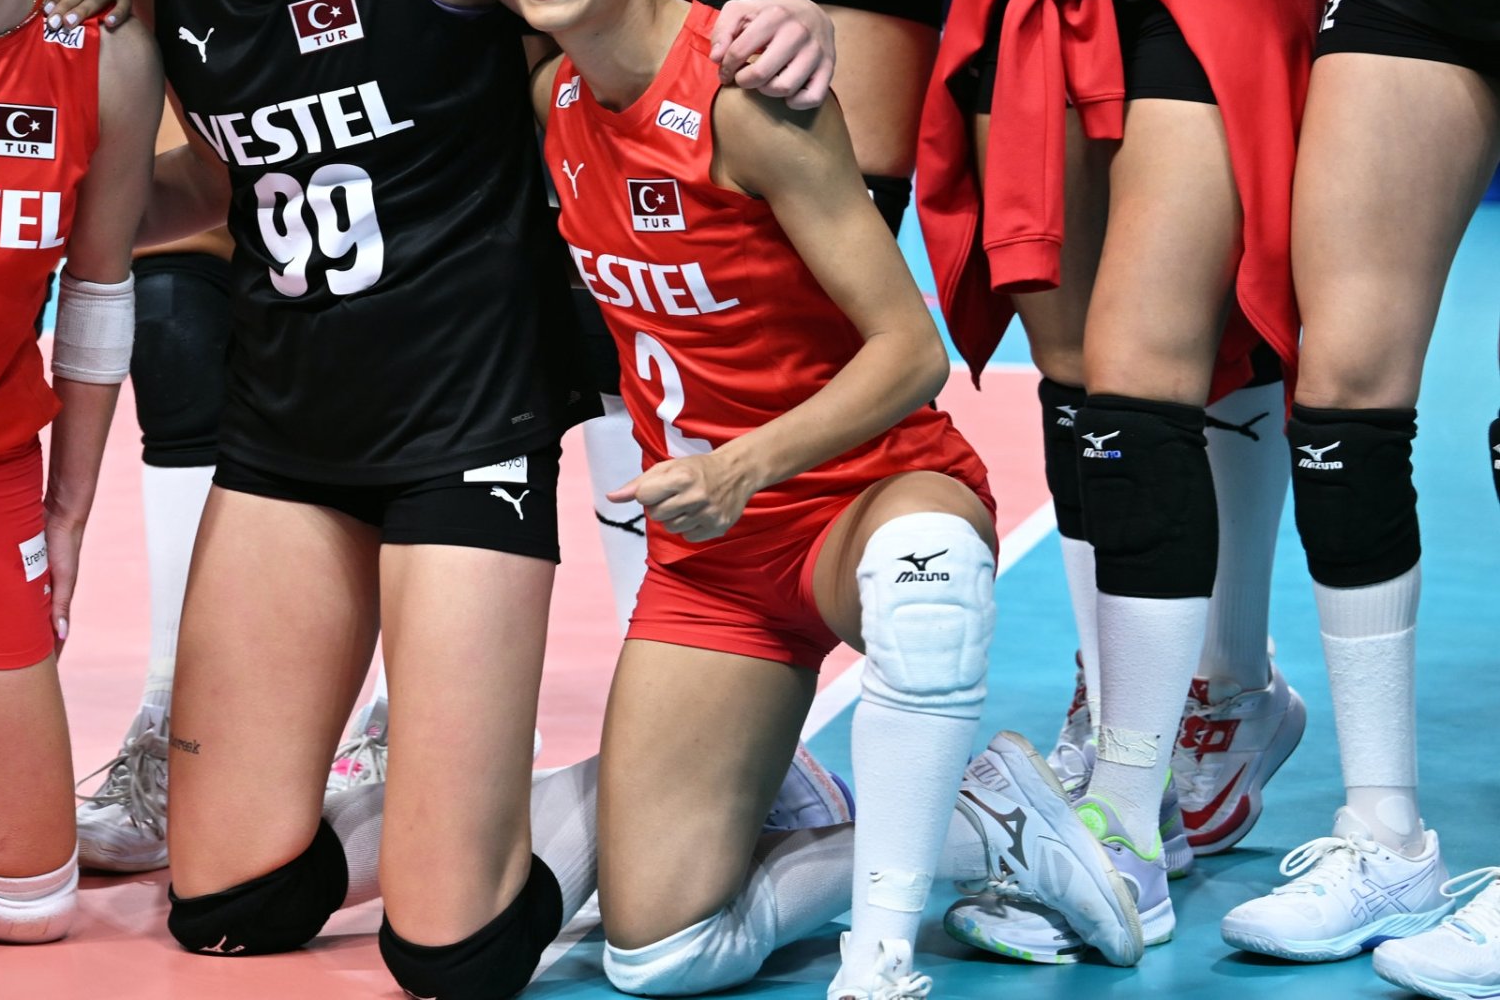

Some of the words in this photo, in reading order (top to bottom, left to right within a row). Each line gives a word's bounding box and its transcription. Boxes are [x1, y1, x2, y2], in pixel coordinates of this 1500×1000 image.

[313, 30, 348, 47] TUR
[189, 80, 415, 166] VESTEL
[5, 142, 40, 155] TUR
[253, 163, 385, 298] 99
[642, 217, 671, 229] TUR
